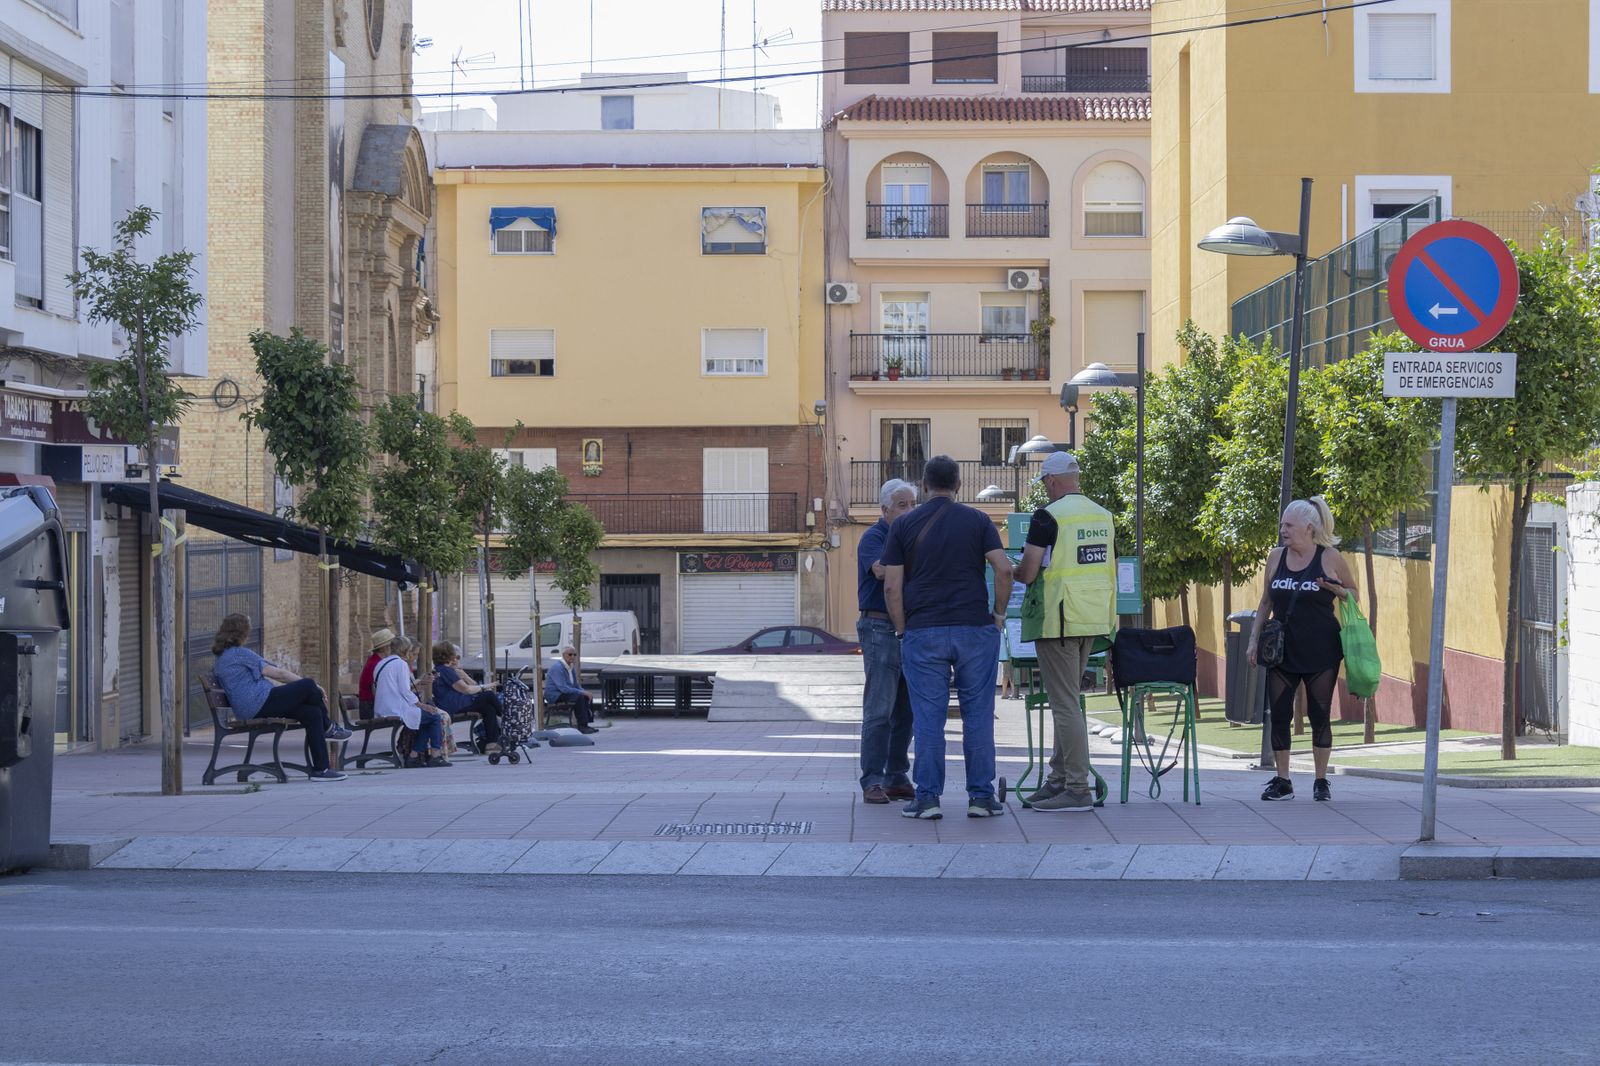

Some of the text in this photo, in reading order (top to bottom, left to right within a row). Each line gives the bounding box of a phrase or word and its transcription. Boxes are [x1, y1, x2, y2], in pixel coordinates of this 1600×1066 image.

[1429, 337, 1465, 348] GRUA
[1392, 361, 1503, 375] ENTRADA SERVICIOS
[1399, 376, 1494, 389] DE EMERGENCIAS
[1085, 529, 1108, 538] ONCE
[704, 555, 723, 570] El
